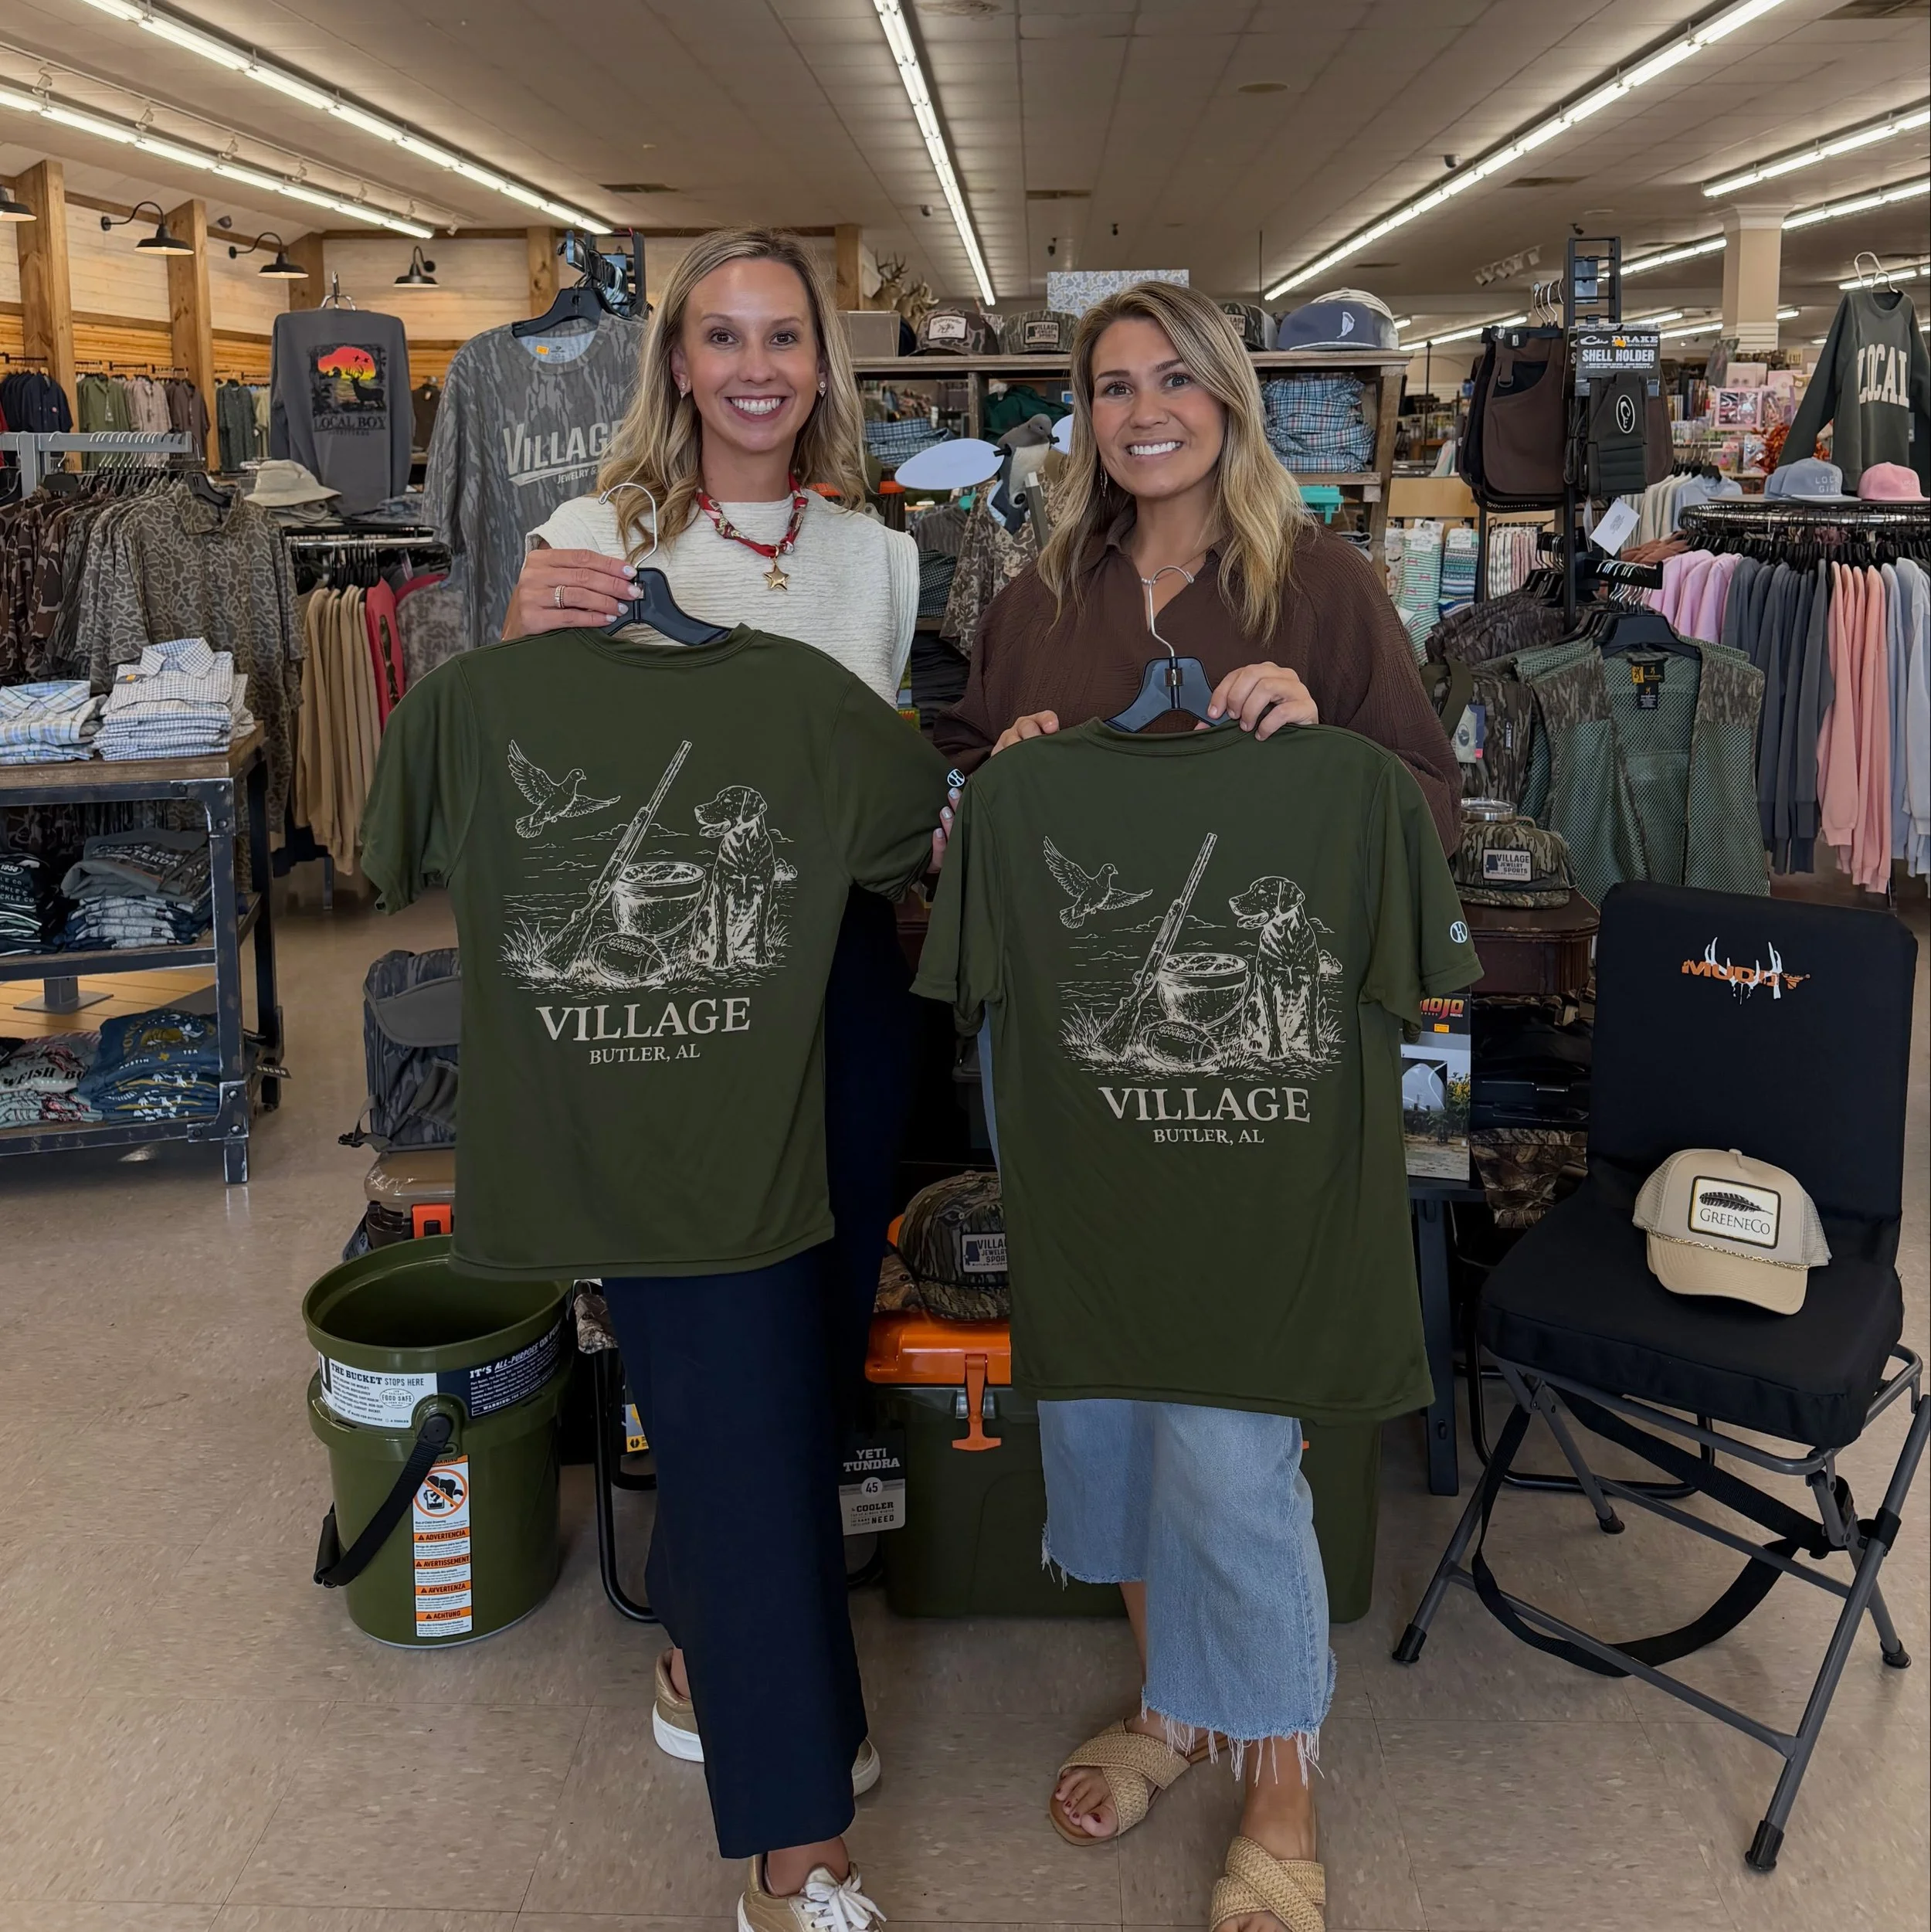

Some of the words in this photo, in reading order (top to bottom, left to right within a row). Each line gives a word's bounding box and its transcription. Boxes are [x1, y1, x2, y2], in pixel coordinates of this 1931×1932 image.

[1582, 349, 1613, 362] SHELL
[1615, 349, 1654, 362] HOLDER
[1858, 344, 1909, 409] LOCAL
[314, 416, 355, 430] LOCAL
[358, 416, 386, 430] BOY
[557, 468, 589, 484] JEWELRY
[1496, 854, 1530, 864] VILLAGE
[0, 885, 20, 895] CKLE
[0, 893, 22, 901] CKLE
[535, 997, 752, 1041] VILLAGE
[589, 1045, 670, 1065] BUTLER,
[675, 1043, 701, 1060] AL
[119, 1058, 149, 1071] AUSTIN
[1098, 1086, 1311, 1124] VILLAGE
[1152, 1128, 1234, 1146] BUTLER,
[1238, 1128, 1264, 1144] AL
[470, 1365, 492, 1379] IT'S
[494, 1343, 539, 1371] ALL-PURPOSE
[331, 1362, 345, 1377] THE
[346, 1369, 382, 1385] BUCKET
[385, 1377, 406, 1387] STOPS
[407, 1377, 425, 1387] HERE
[855, 1447, 887, 1460] YETI
[843, 1457, 901, 1472] TUNDRA
[865, 1482, 878, 1493] 45
[856, 1501, 894, 1513] COOLER
[871, 1514, 894, 1524] NEED
[425, 1530, 466, 1540] ADVERTENCIA
[423, 1555, 470, 1567] AVERTISSEMENT
[428, 1583, 466, 1594] AVVERTENZA
[433, 1610, 461, 1620] ACHTUNG
